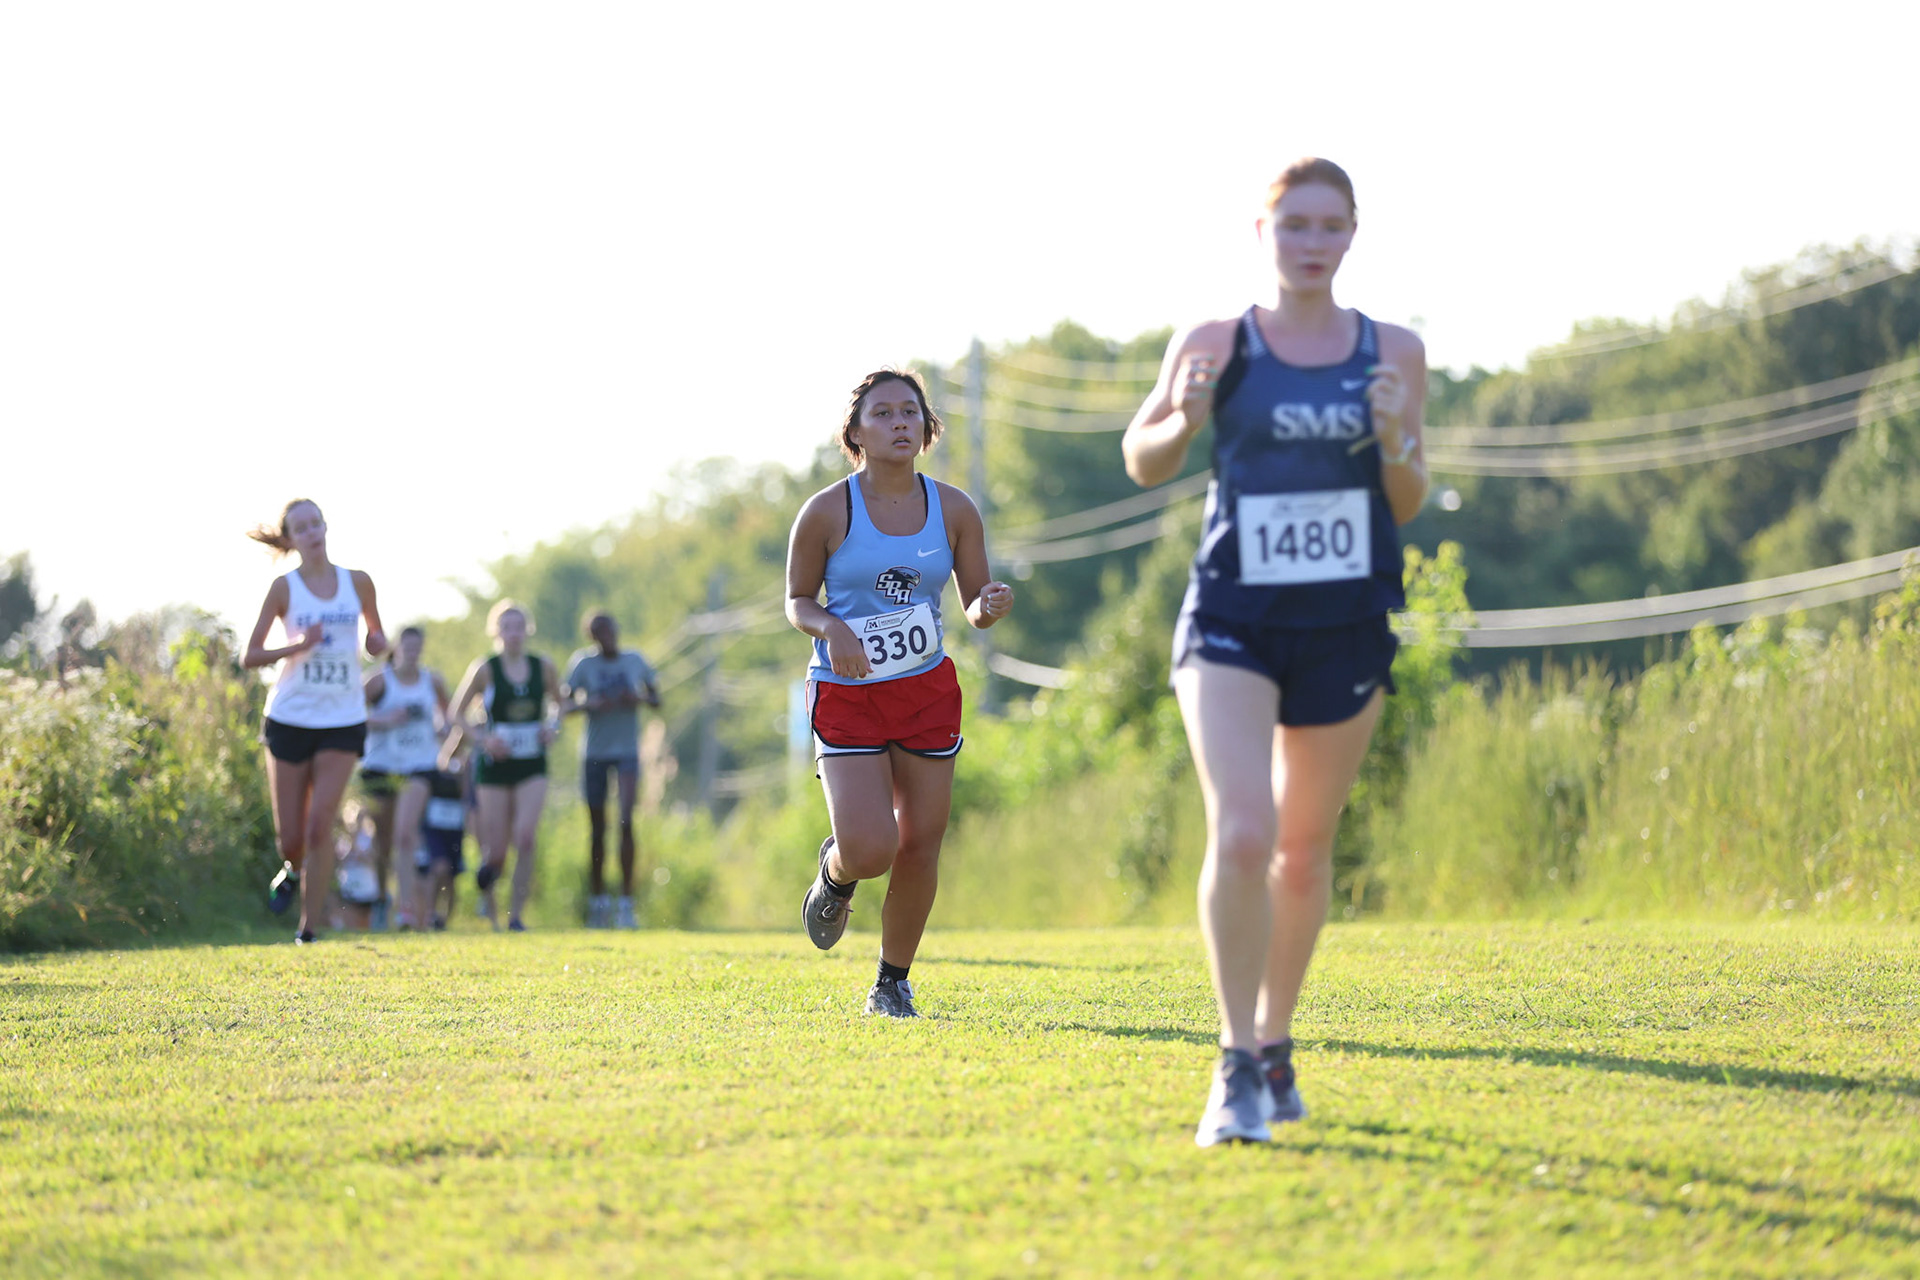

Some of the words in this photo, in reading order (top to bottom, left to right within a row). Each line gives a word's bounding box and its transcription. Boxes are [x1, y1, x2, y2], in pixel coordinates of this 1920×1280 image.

[1273, 403, 1363, 440] SMS
[1256, 518, 1354, 563] 1480
[877, 573, 912, 605] SBA
[858, 625, 927, 665] 330
